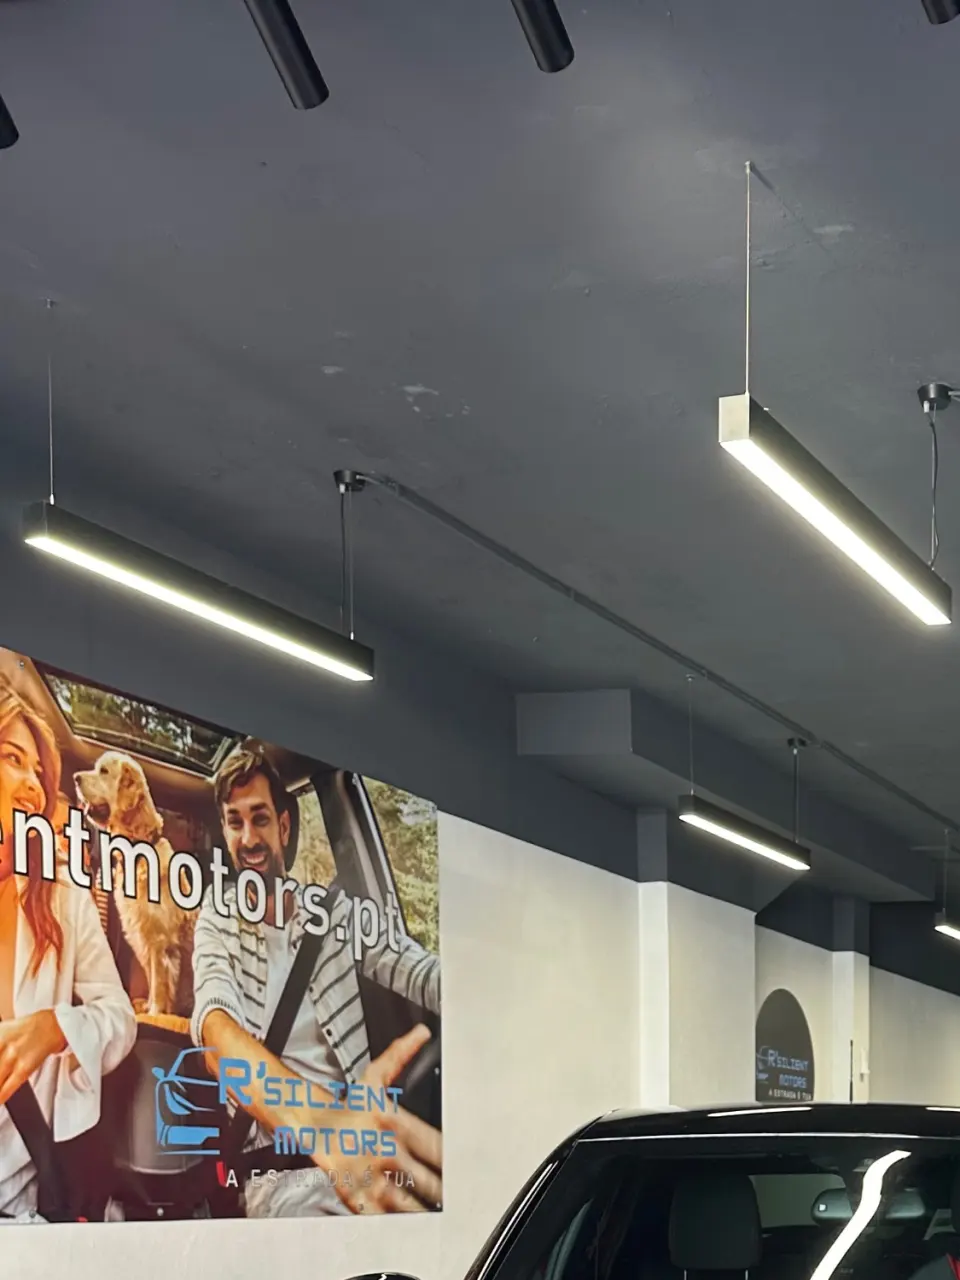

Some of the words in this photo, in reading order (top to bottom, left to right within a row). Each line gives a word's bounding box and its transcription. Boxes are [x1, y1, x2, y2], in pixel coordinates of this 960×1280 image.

[0, 807, 401, 961] ntmotors.pt
[218, 1057, 403, 1113] R'SILIENT
[274, 1126, 397, 1157] MOTORS
[225, 1169, 239, 1188] A
[251, 1168, 354, 1188] ESTRADA
[383, 1170, 415, 1188] TUA
